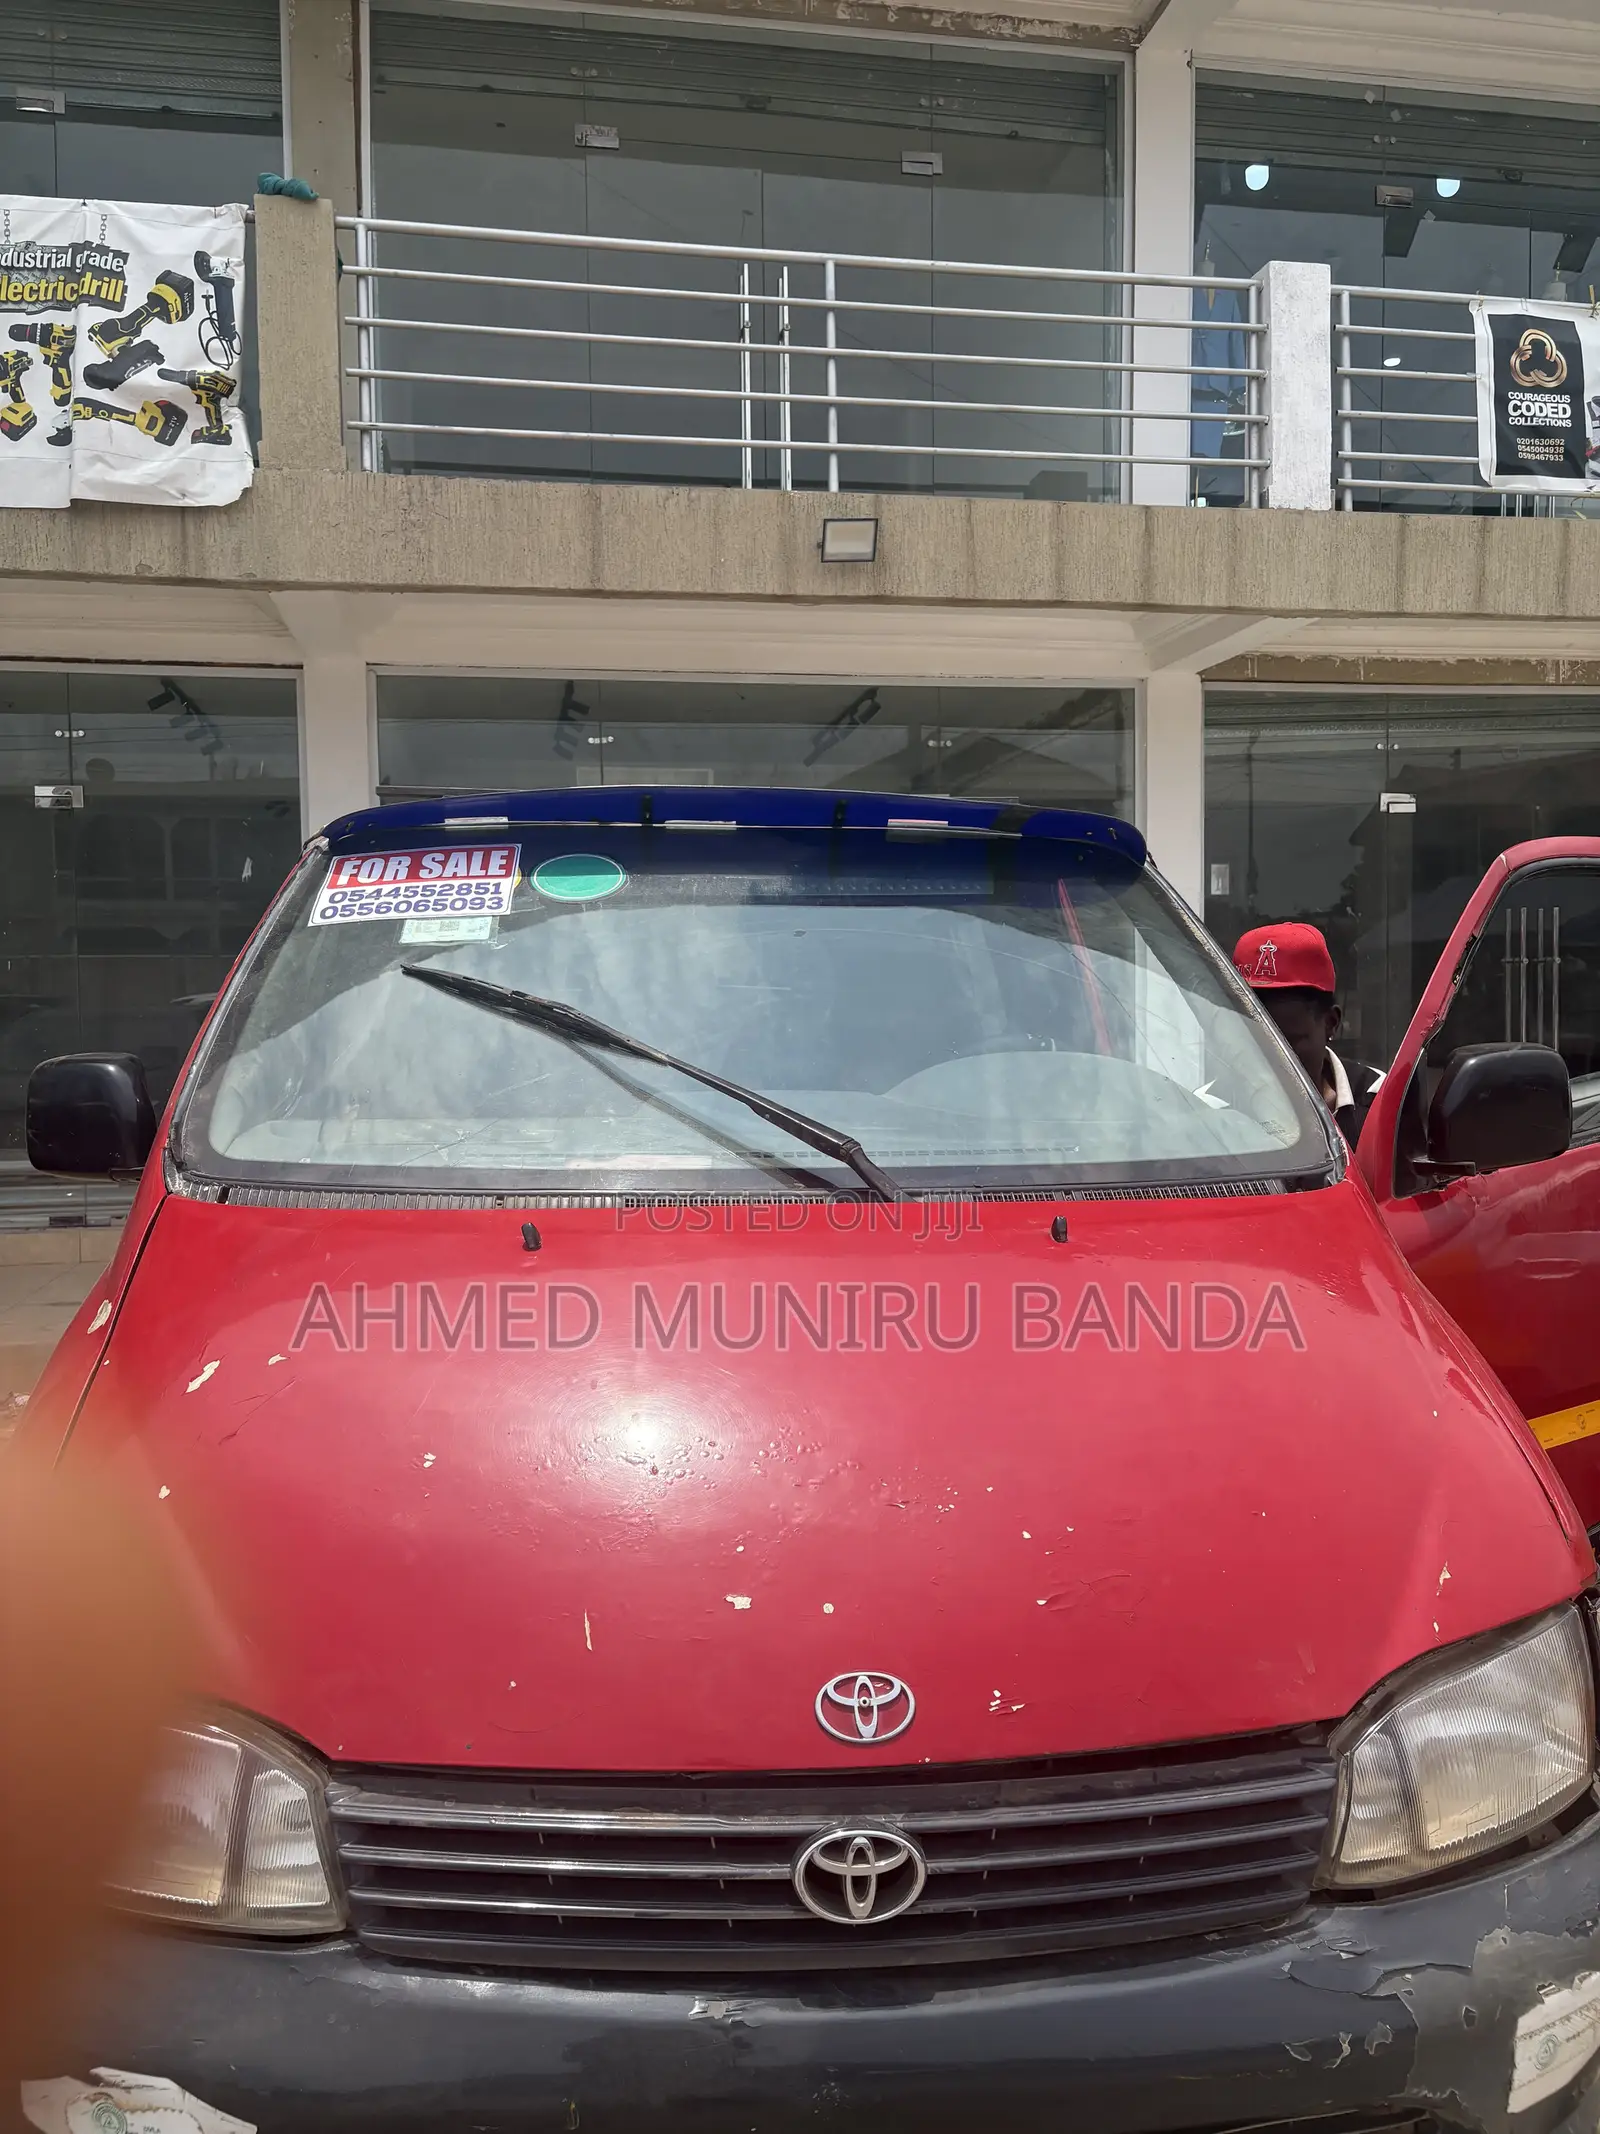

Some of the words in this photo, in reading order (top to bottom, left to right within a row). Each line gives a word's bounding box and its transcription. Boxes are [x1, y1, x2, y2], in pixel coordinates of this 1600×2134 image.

[0, 247, 72, 268] dustrial
[75, 250, 124, 272] grade
[1508, 392, 1571, 403] COURAGEOUS
[1508, 400, 1571, 419] CODED
[1509, 417, 1572, 427] COLLECTIONS
[1516, 437, 1565, 446] 0201630692
[335, 855, 412, 886] FOR
[418, 850, 509, 879] SALE
[328, 882, 502, 904] 0544552851
[319, 896, 504, 920] 0556065093
